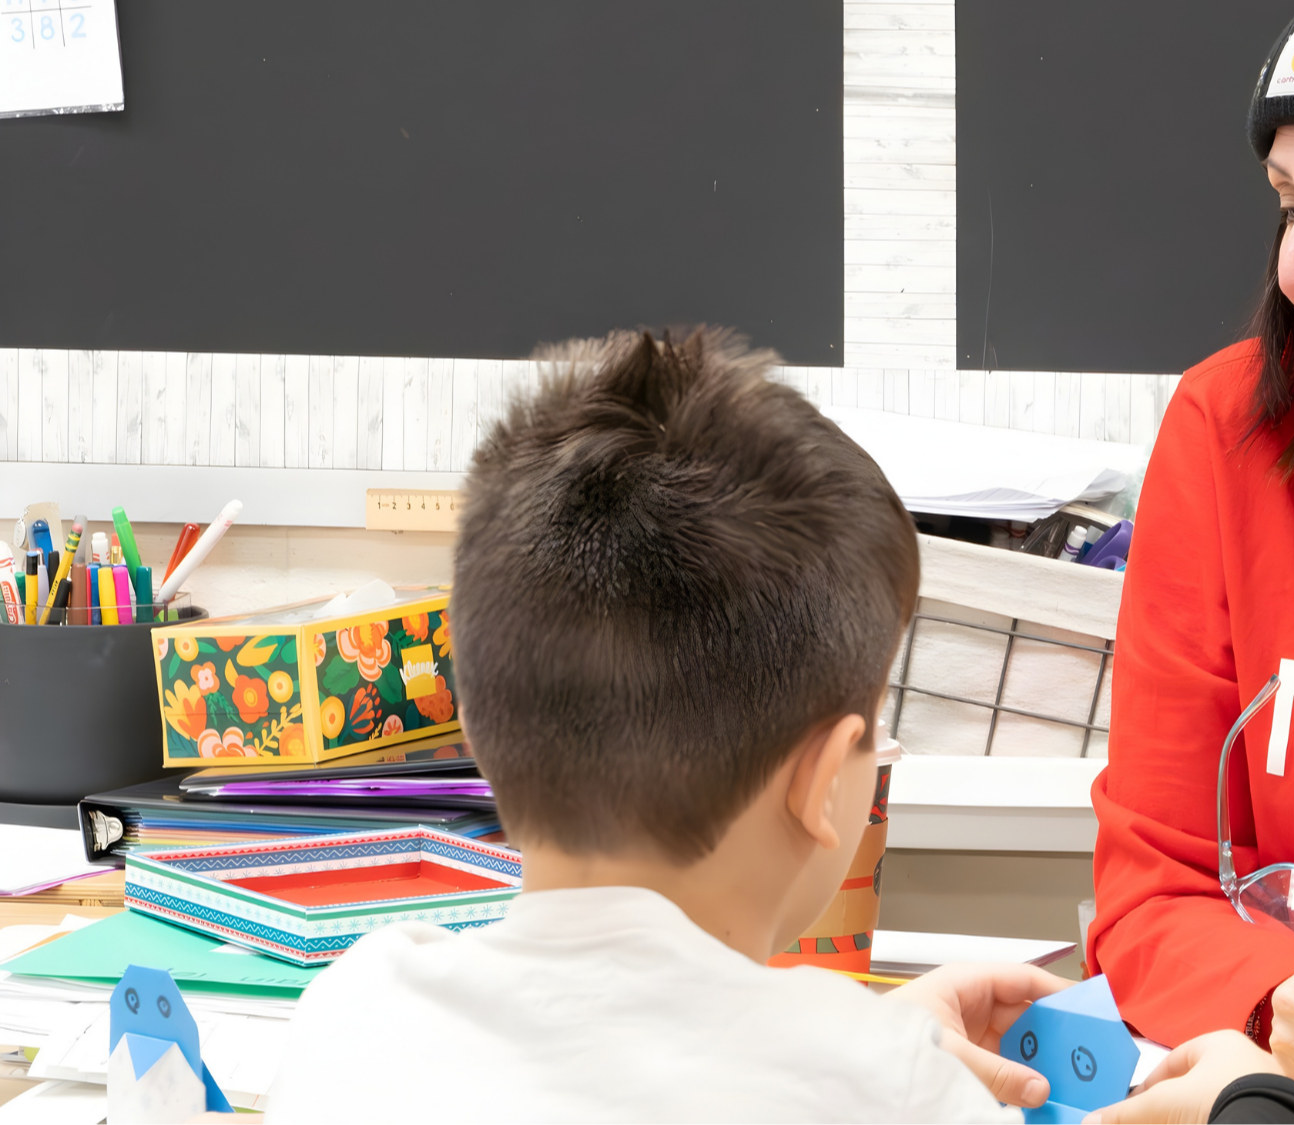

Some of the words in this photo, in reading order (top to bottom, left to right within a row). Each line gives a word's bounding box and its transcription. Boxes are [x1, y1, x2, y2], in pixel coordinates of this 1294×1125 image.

[11, 17, 25, 42] 3
[41, 15, 55, 40] 8
[69, 13, 87, 38] 2
